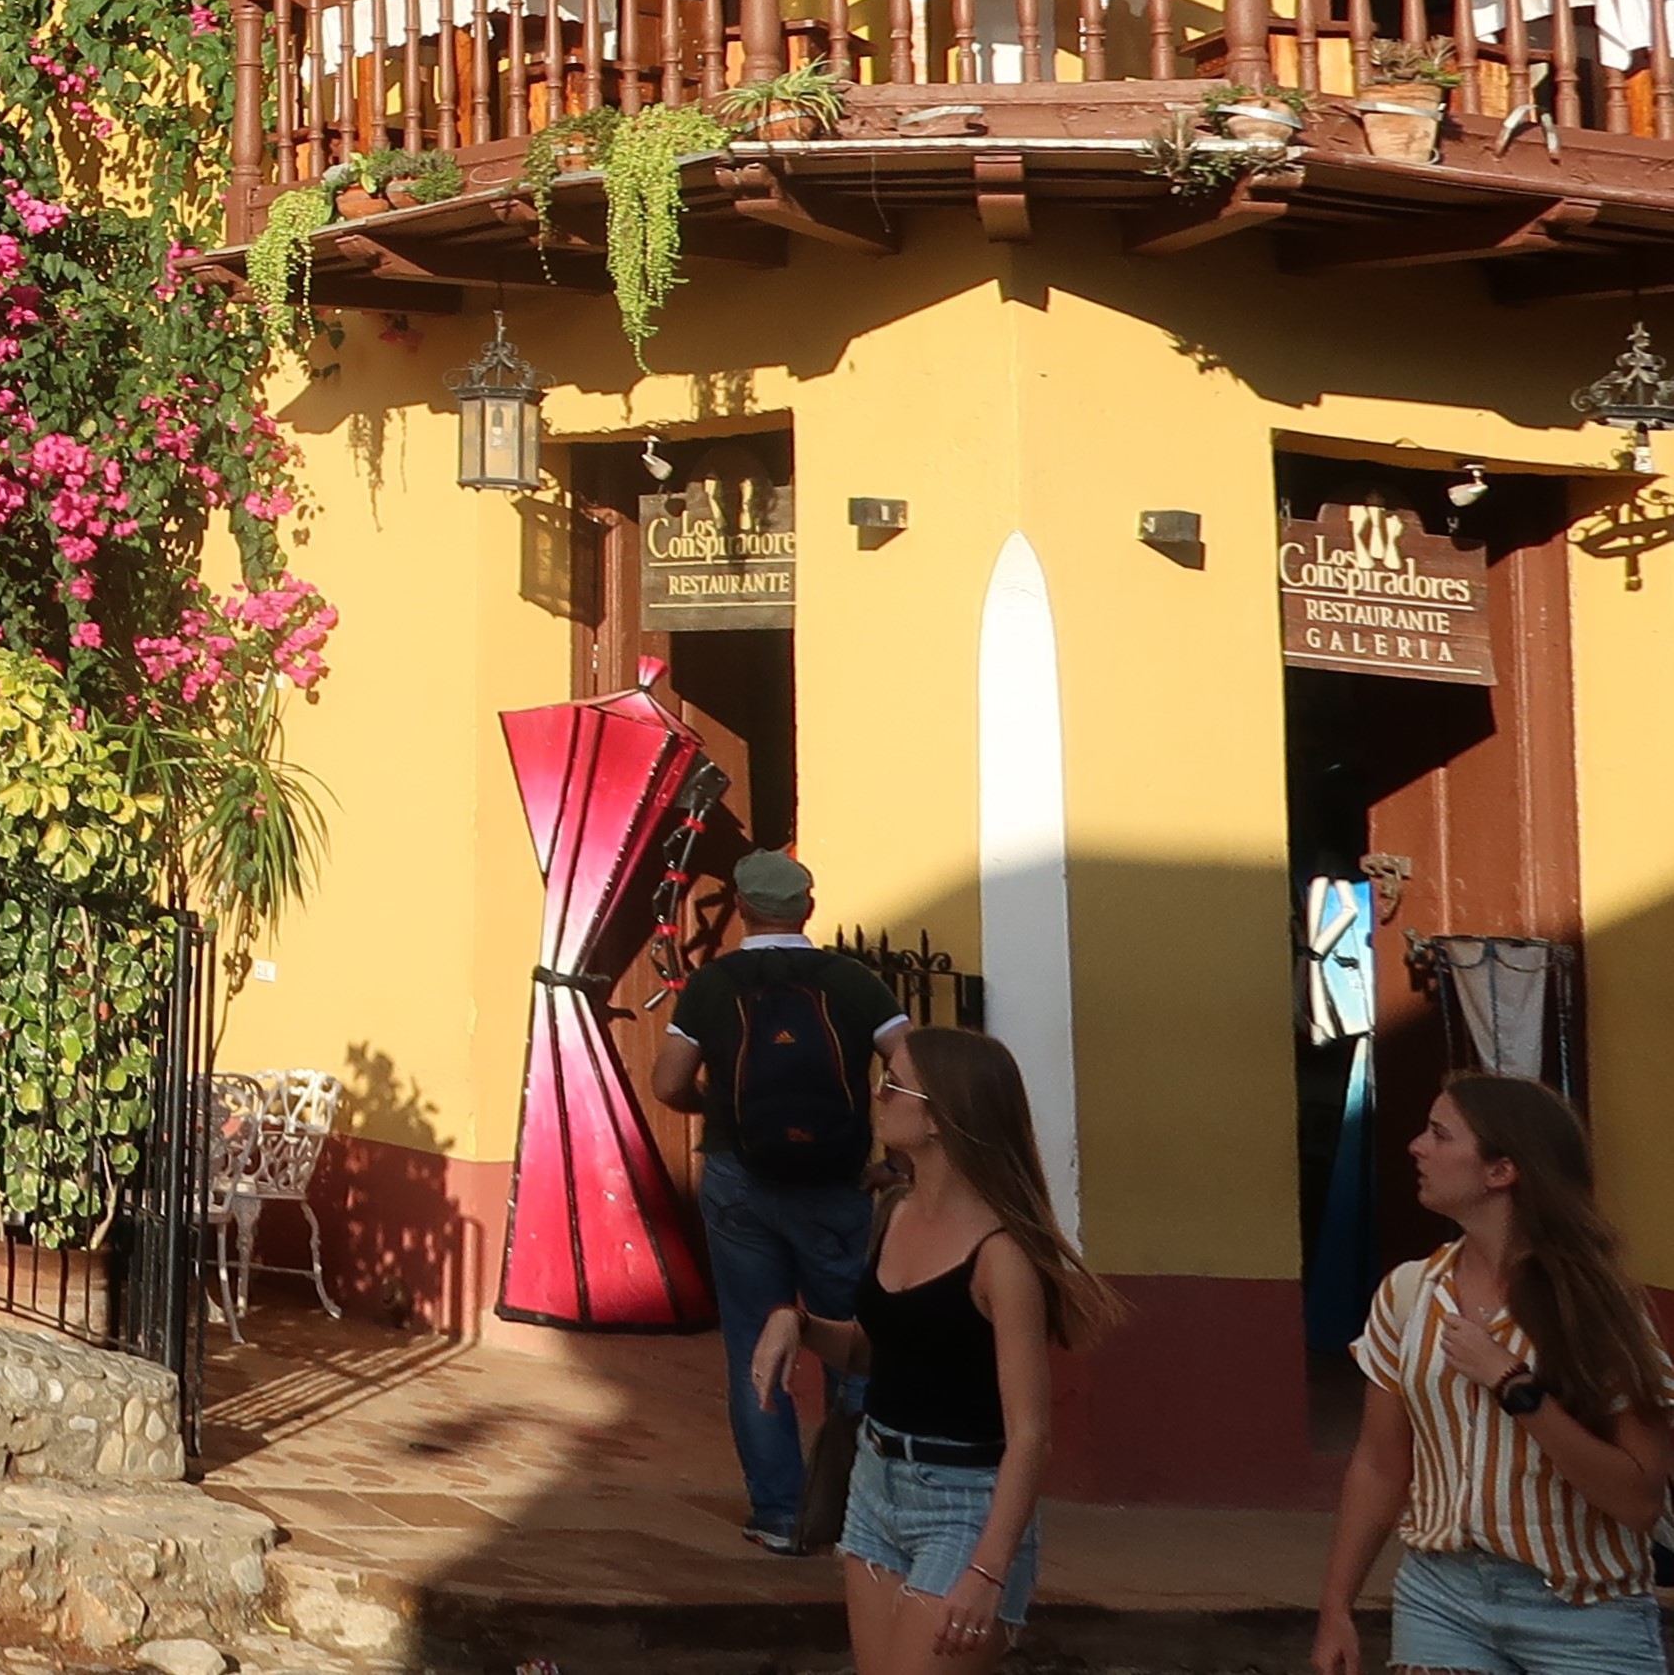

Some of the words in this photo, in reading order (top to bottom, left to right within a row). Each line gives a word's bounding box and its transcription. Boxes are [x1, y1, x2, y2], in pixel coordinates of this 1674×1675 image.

[648, 518, 796, 564] Conspiradore
[681, 510, 716, 539] Los
[1315, 534, 1357, 568] Los
[668, 573, 791, 595] RESTAURANTE
[1279, 542, 1471, 602] Conspiradores
[1305, 598, 1450, 635] RESTAURANTE
[1306, 627, 1454, 662] GALERIA
